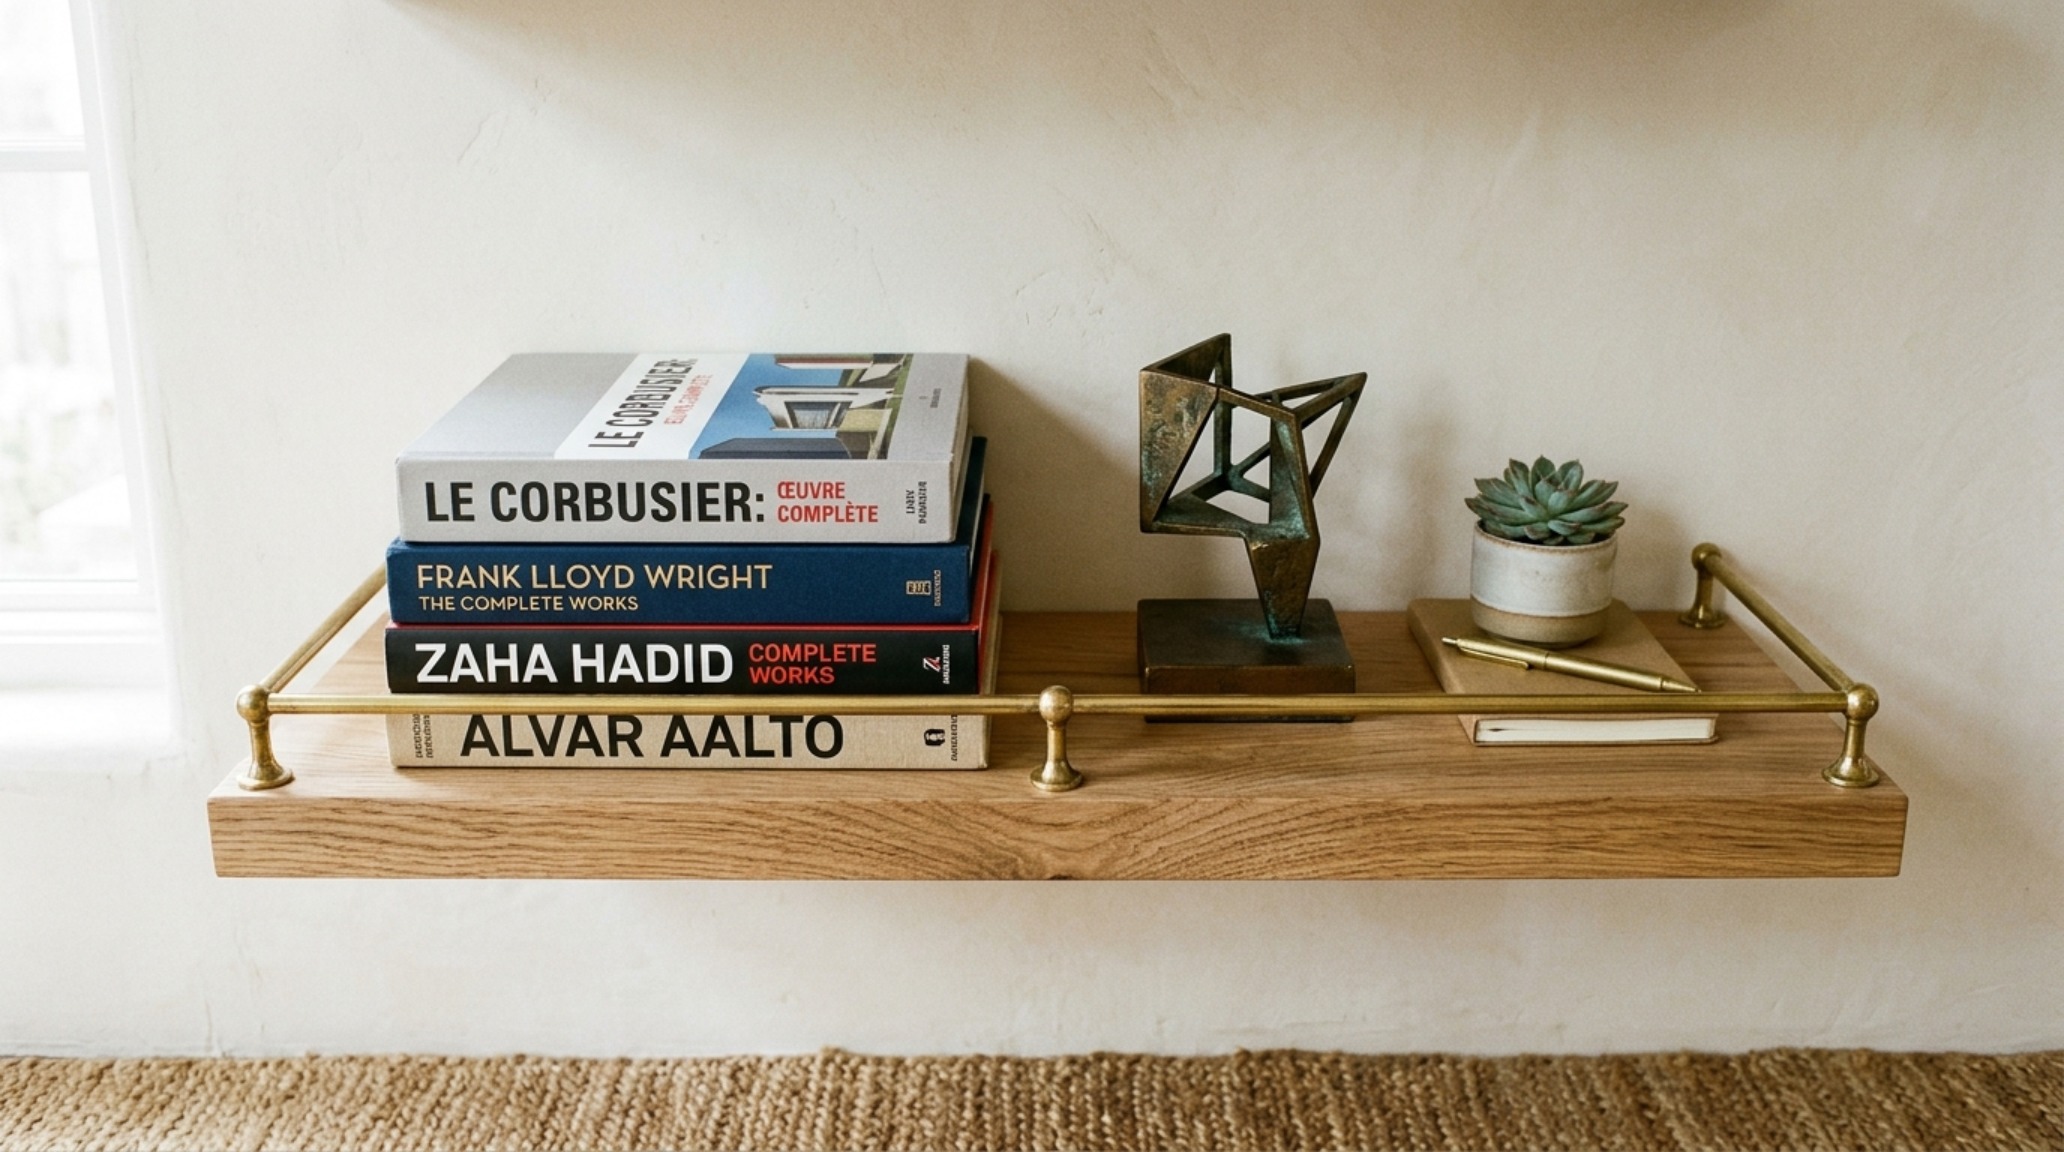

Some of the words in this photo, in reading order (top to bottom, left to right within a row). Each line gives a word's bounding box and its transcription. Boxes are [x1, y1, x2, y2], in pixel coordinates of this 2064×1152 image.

[588, 431, 644, 448] LE
[777, 481, 845, 499] ŒUVRE
[425, 482, 475, 522] LE
[490, 481, 765, 523] CORBUSIER:
[777, 501, 878, 523] COMPLÈTE
[417, 564, 521, 589] FRANK
[531, 564, 635, 589] LLOYD
[643, 564, 773, 589] WRIGHT
[418, 596, 456, 611] THE
[460, 596, 564, 611] COMPLETE
[568, 596, 639, 611] WORKS
[414, 642, 558, 683] ZAHA
[572, 643, 733, 683] HADID
[748, 643, 877, 663] COMPLETE
[748, 664, 836, 684] WORKS
[460, 714, 644, 757] ALVAR
[660, 714, 844, 759] AALTO
